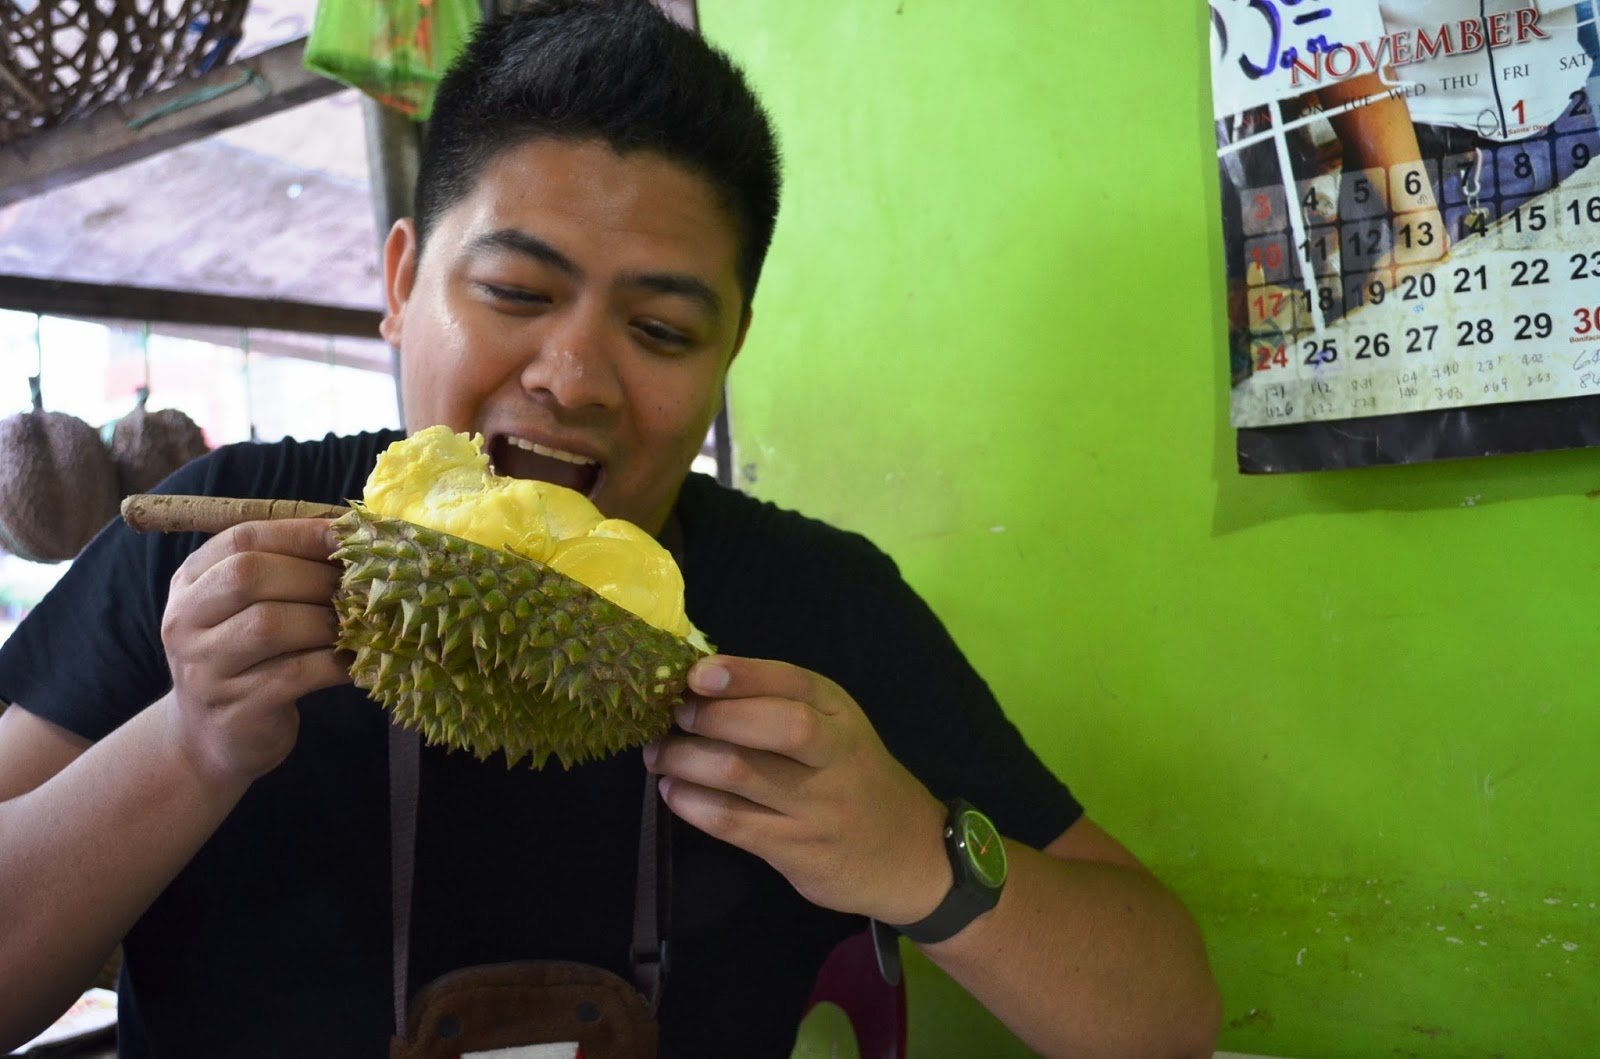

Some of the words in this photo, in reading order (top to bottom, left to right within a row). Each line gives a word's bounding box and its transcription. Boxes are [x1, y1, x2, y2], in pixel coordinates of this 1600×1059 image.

[1289, 7, 1550, 87] NOVEMBER
[1388, 83, 1426, 101] WED
[1440, 73, 1479, 91] THU
[1503, 64, 1530, 81] FRI
[1559, 53, 1596, 71] SAT
[1512, 100, 1525, 125] 1
[1569, 90, 1588, 117] 2
[1253, 193, 1272, 221] 3
[1301, 186, 1320, 211] 4
[1353, 179, 1370, 204] 5
[1404, 171, 1422, 195] 6
[1457, 161, 1474, 188] 7
[1513, 152, 1532, 179] 8
[1571, 142, 1590, 169] 9
[1251, 243, 1283, 270] 10
[1299, 236, 1328, 262] 11
[1349, 229, 1383, 256] 12
[1398, 222, 1434, 248] 13
[1508, 205, 1547, 233] 15
[1253, 292, 1284, 321] 17
[1302, 286, 1334, 313] 18
[1351, 280, 1386, 307] 19
[1401, 273, 1437, 301] 20
[1453, 264, 1488, 294] 21
[1510, 258, 1550, 287] 22
[1256, 343, 1289, 371] 24
[1303, 338, 1338, 365] 25
[1354, 332, 1390, 360] 26
[1405, 325, 1439, 353] 27
[1456, 318, 1495, 347] 28
[1513, 312, 1553, 341] 29
[1569, 335, 1600, 344] Bonifaci
